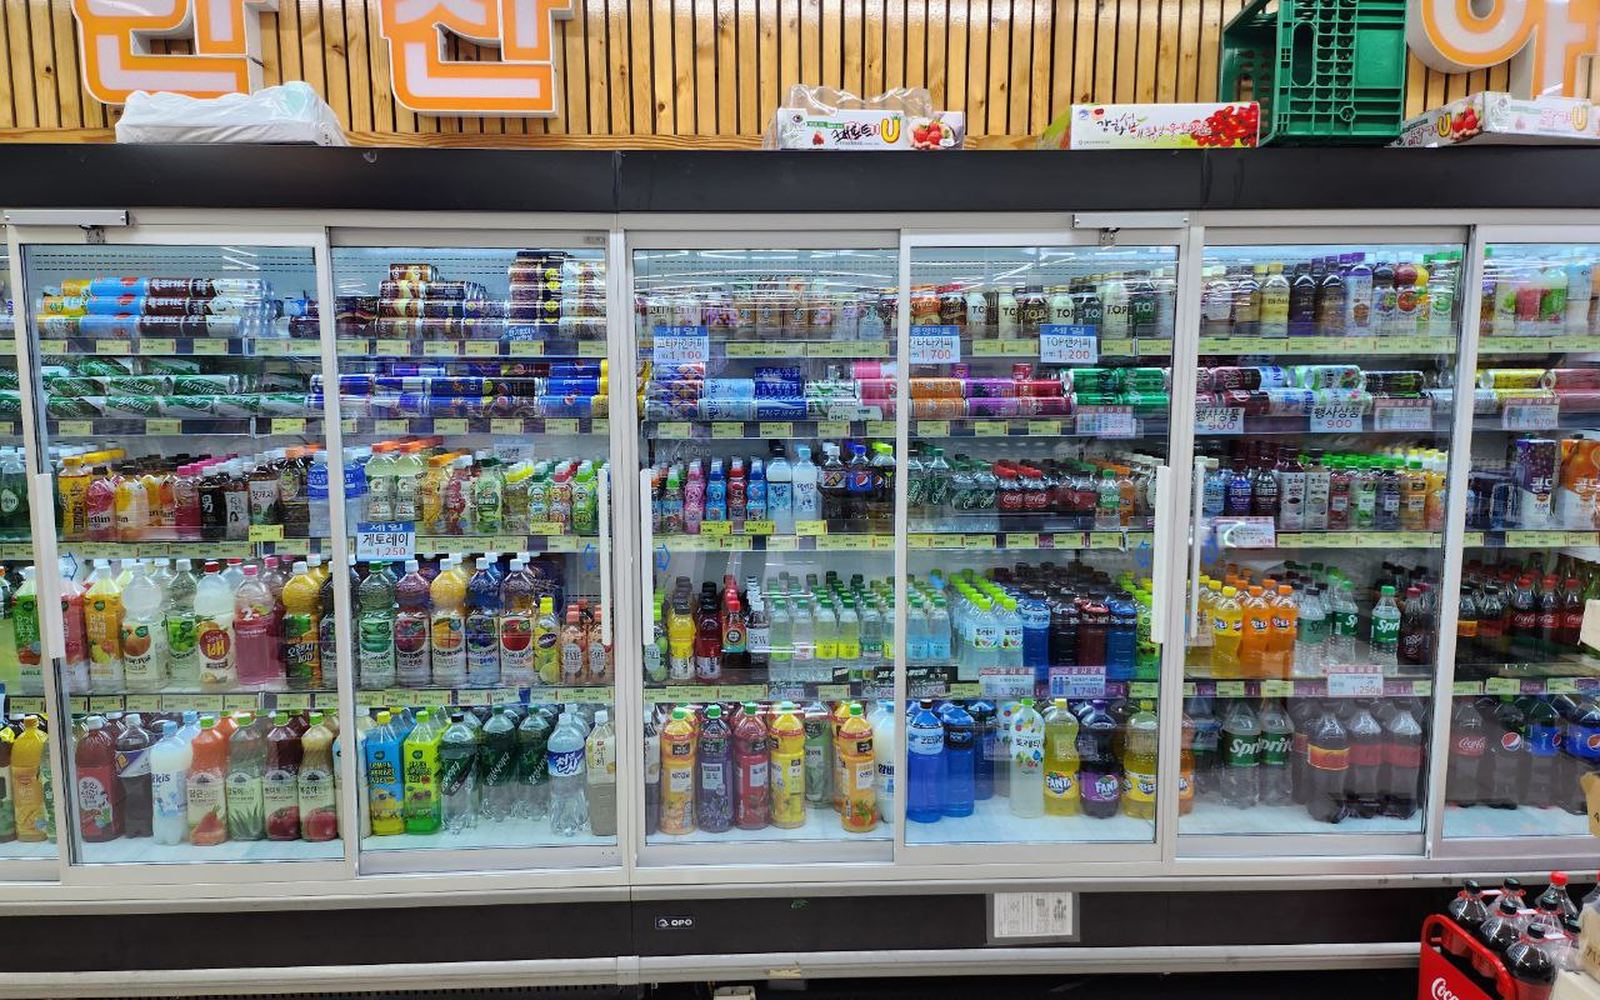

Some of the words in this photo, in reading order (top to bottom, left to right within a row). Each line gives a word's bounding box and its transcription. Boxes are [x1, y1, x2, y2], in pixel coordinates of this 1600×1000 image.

[1051, 327, 1084, 336] 세일
[1208, 422, 1235, 431] 900
[1327, 419, 1353, 429] 900
[363, 533, 409, 547] 게토레이
[376, 547, 406, 558] 1,250
